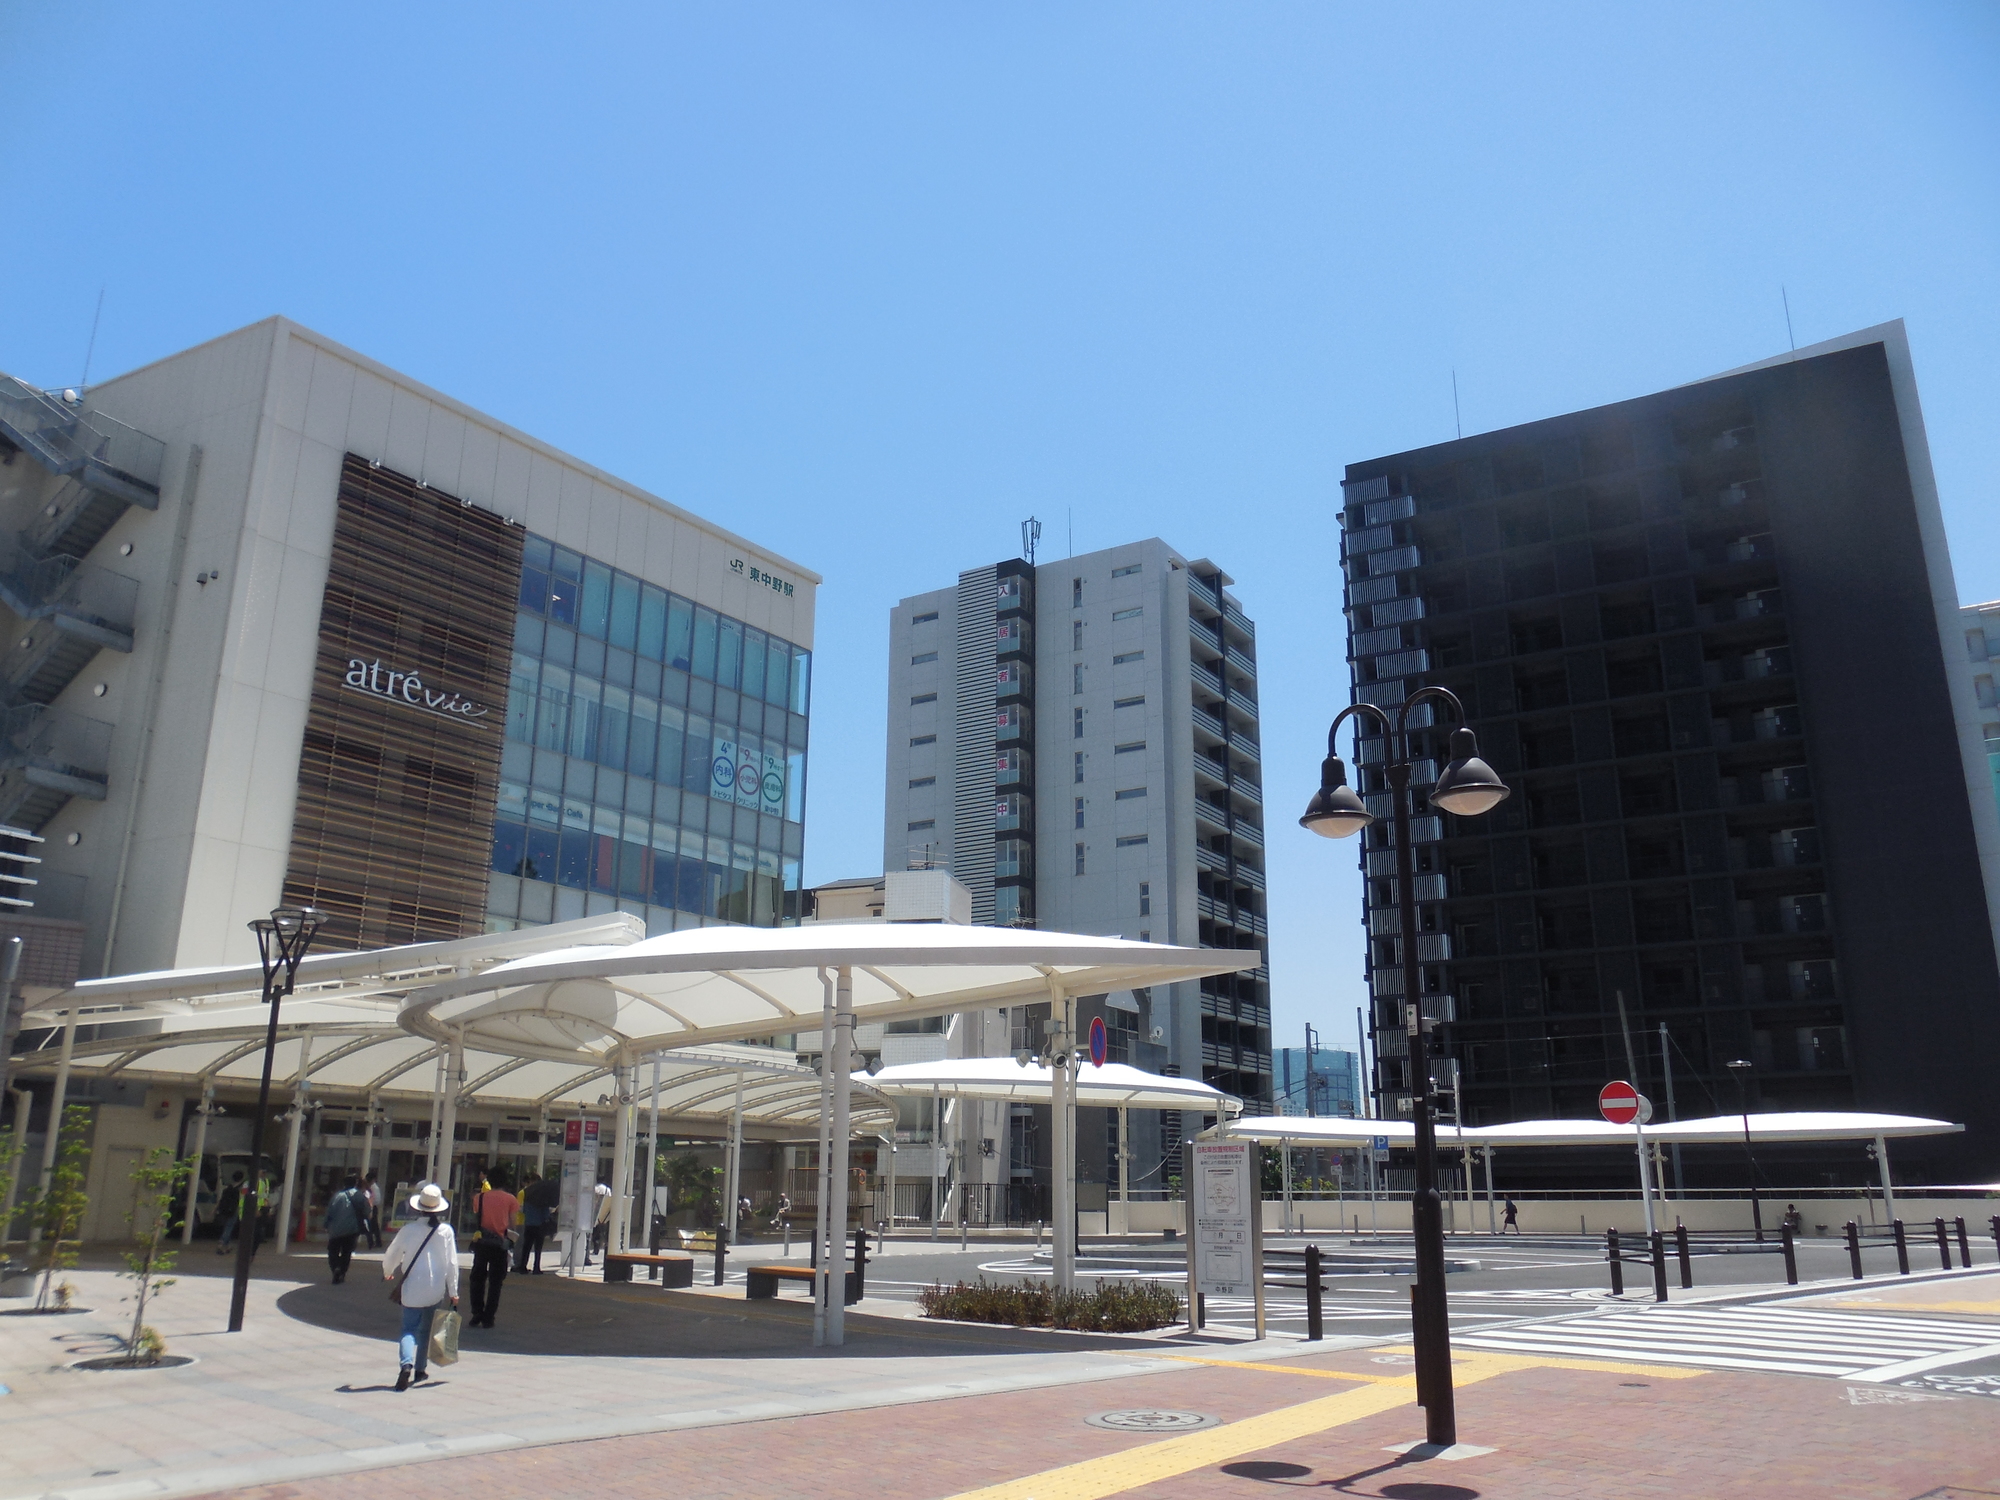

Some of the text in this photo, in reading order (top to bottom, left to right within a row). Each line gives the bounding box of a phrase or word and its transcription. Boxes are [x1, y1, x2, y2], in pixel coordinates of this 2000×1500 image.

[730, 558, 744, 571] JR
[749, 566, 794, 598] 東中野駅
[345, 657, 422, 704] atré
[715, 764, 732, 778] 内科
[1377, 1136, 1386, 1148] P
[1215, 1286, 1234, 1294] 中野区
